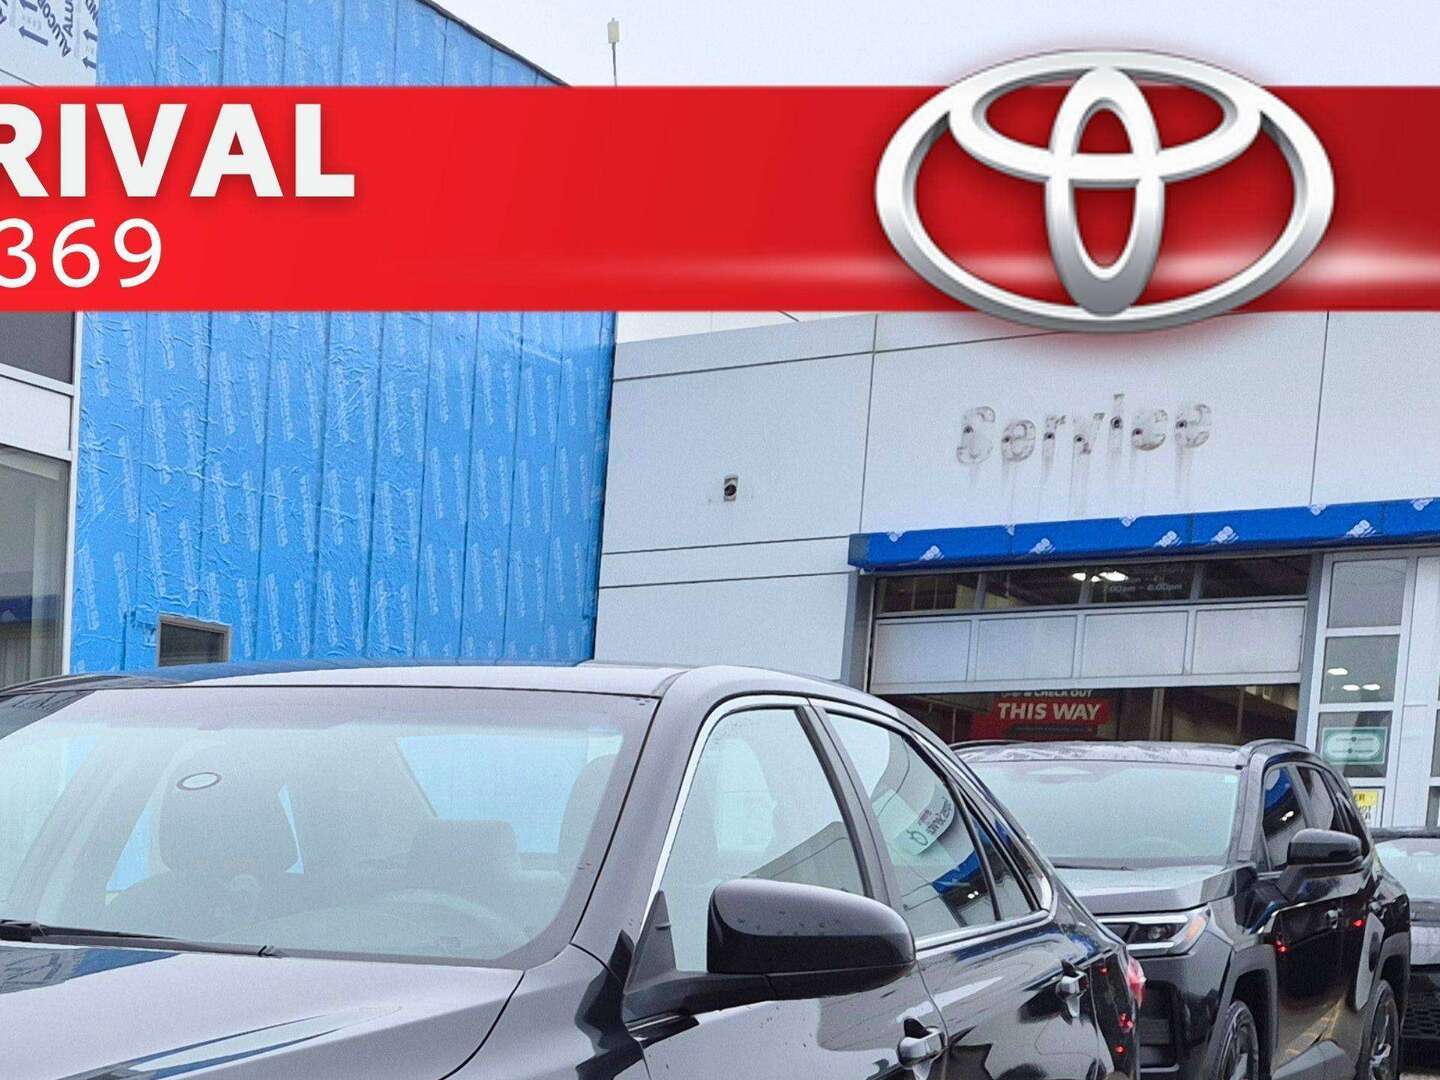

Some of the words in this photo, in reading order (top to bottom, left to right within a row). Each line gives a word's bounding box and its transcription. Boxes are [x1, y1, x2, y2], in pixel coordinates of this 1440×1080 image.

[956, 392, 1213, 465] Service
[998, 702, 1047, 720] THIS
[1053, 702, 1101, 720] WAY
